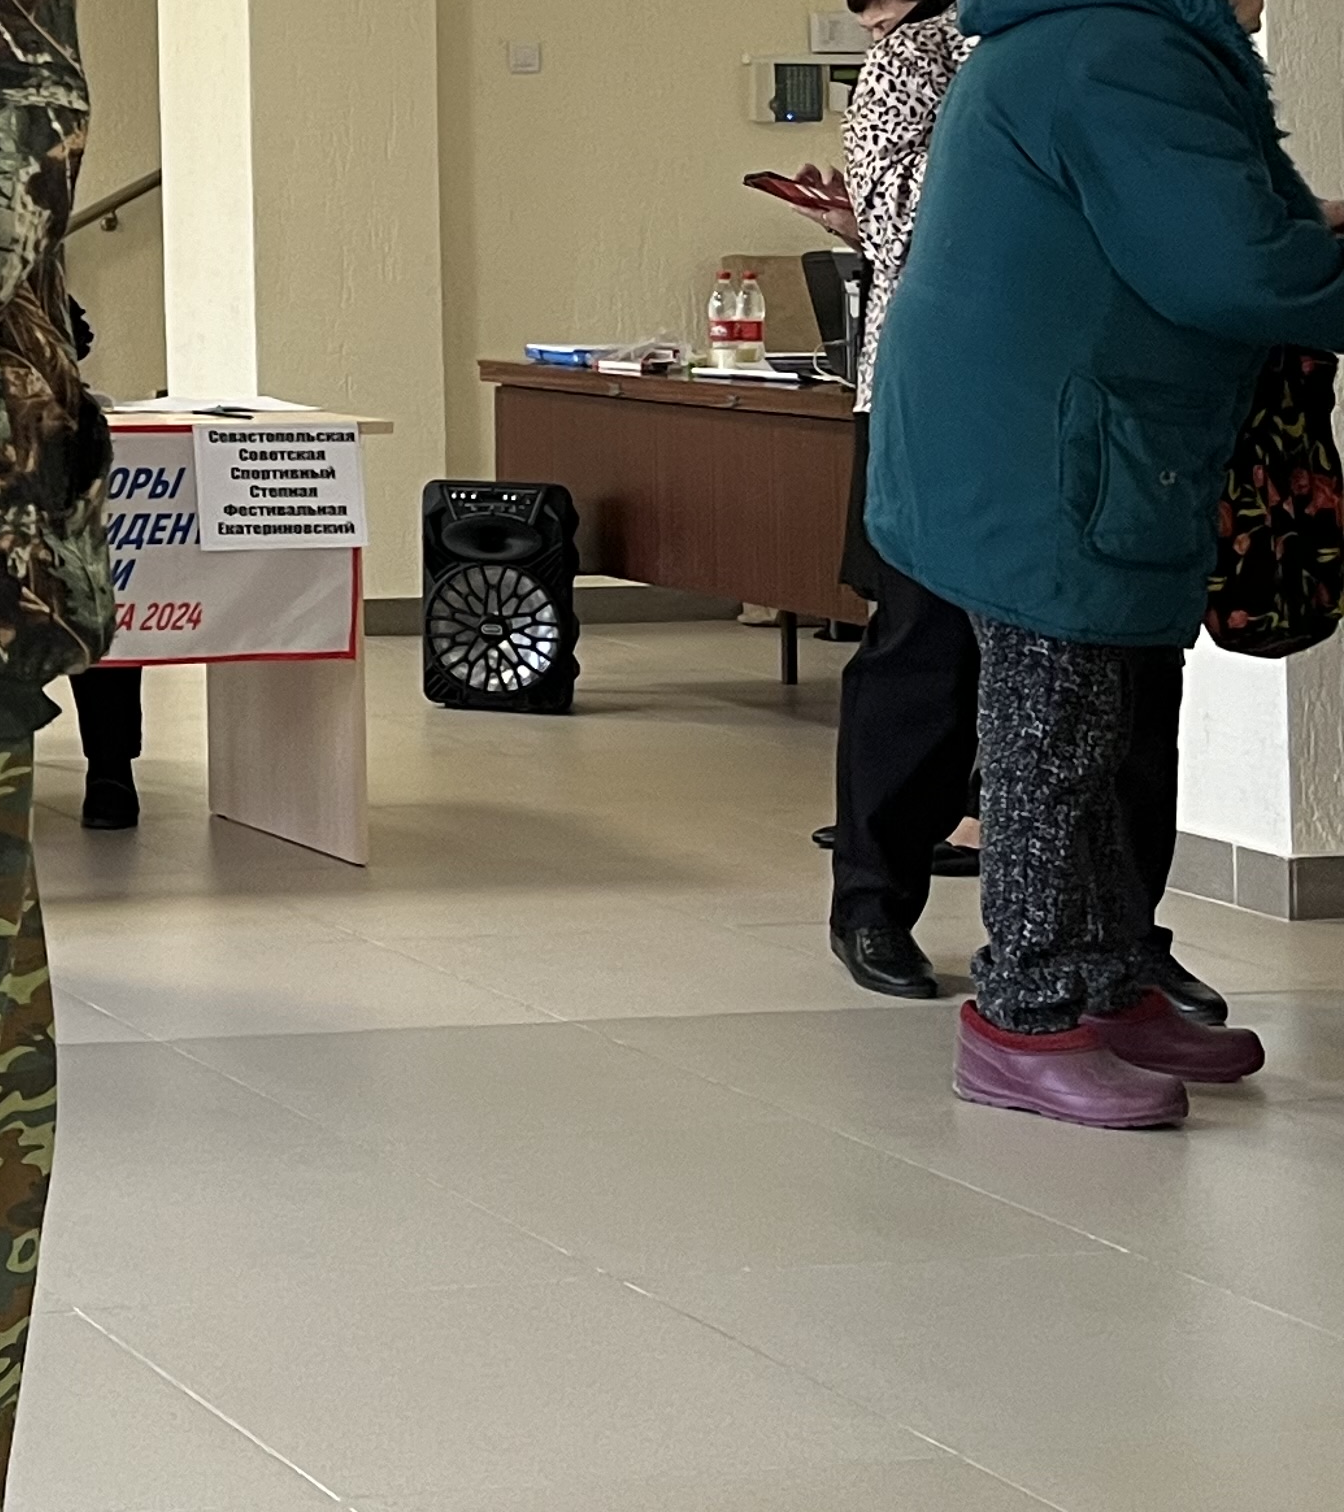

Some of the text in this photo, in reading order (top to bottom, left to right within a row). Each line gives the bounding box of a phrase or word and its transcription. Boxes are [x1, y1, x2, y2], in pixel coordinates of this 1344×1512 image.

[208, 429, 356, 444] Севастопольская
[238, 447, 326, 462] Советская
[230, 465, 336, 481] Спортивный
[249, 484, 319, 499] Степная
[223, 503, 348, 517] Фестивальная
[217, 521, 356, 536] Екатериновский
[139, 601, 203, 631] 2024
